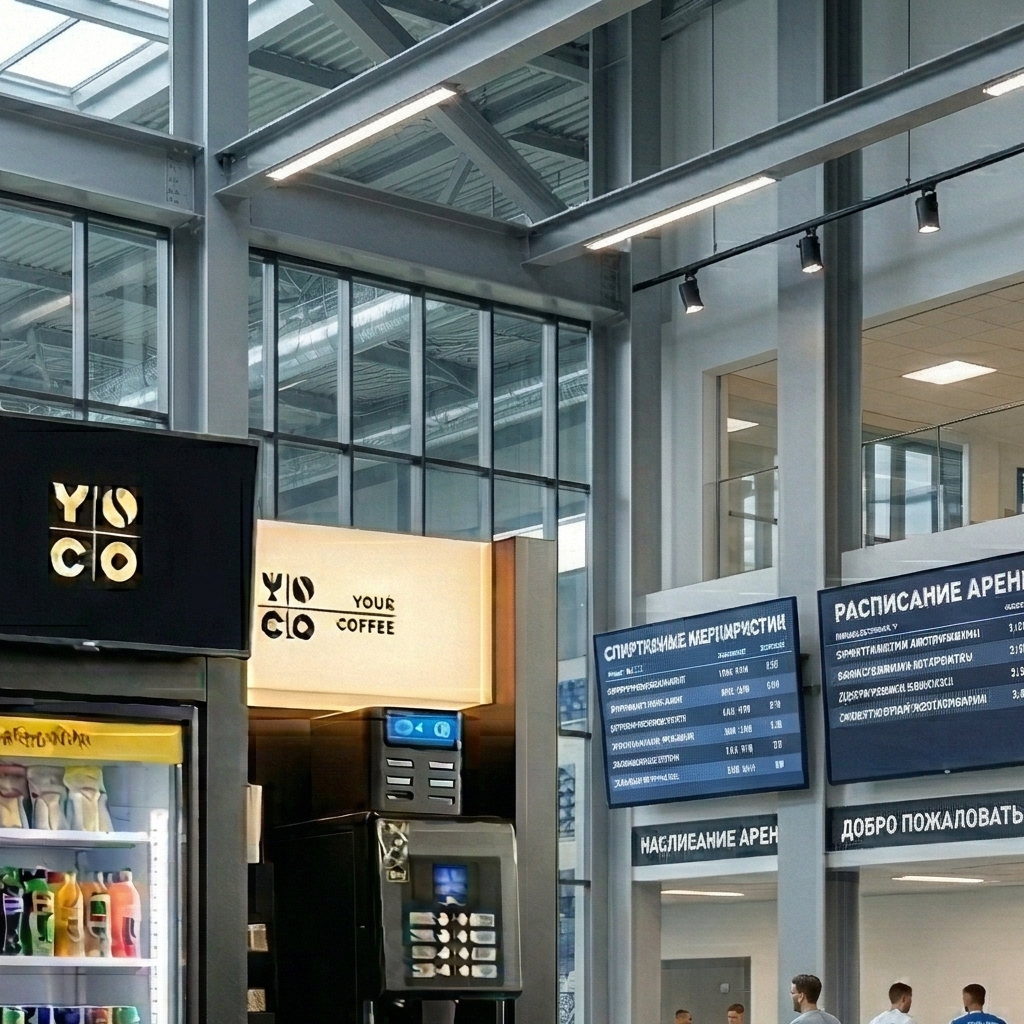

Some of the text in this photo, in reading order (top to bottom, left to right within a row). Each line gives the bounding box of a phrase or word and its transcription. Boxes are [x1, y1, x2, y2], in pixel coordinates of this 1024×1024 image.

[834, 567, 1024, 623] РАСПИСАНИЕ АРЕН
[336, 617, 395, 635] COFFEE
[841, 804, 1024, 842] ДОБРО ПОЖАЛОВАТЬ
